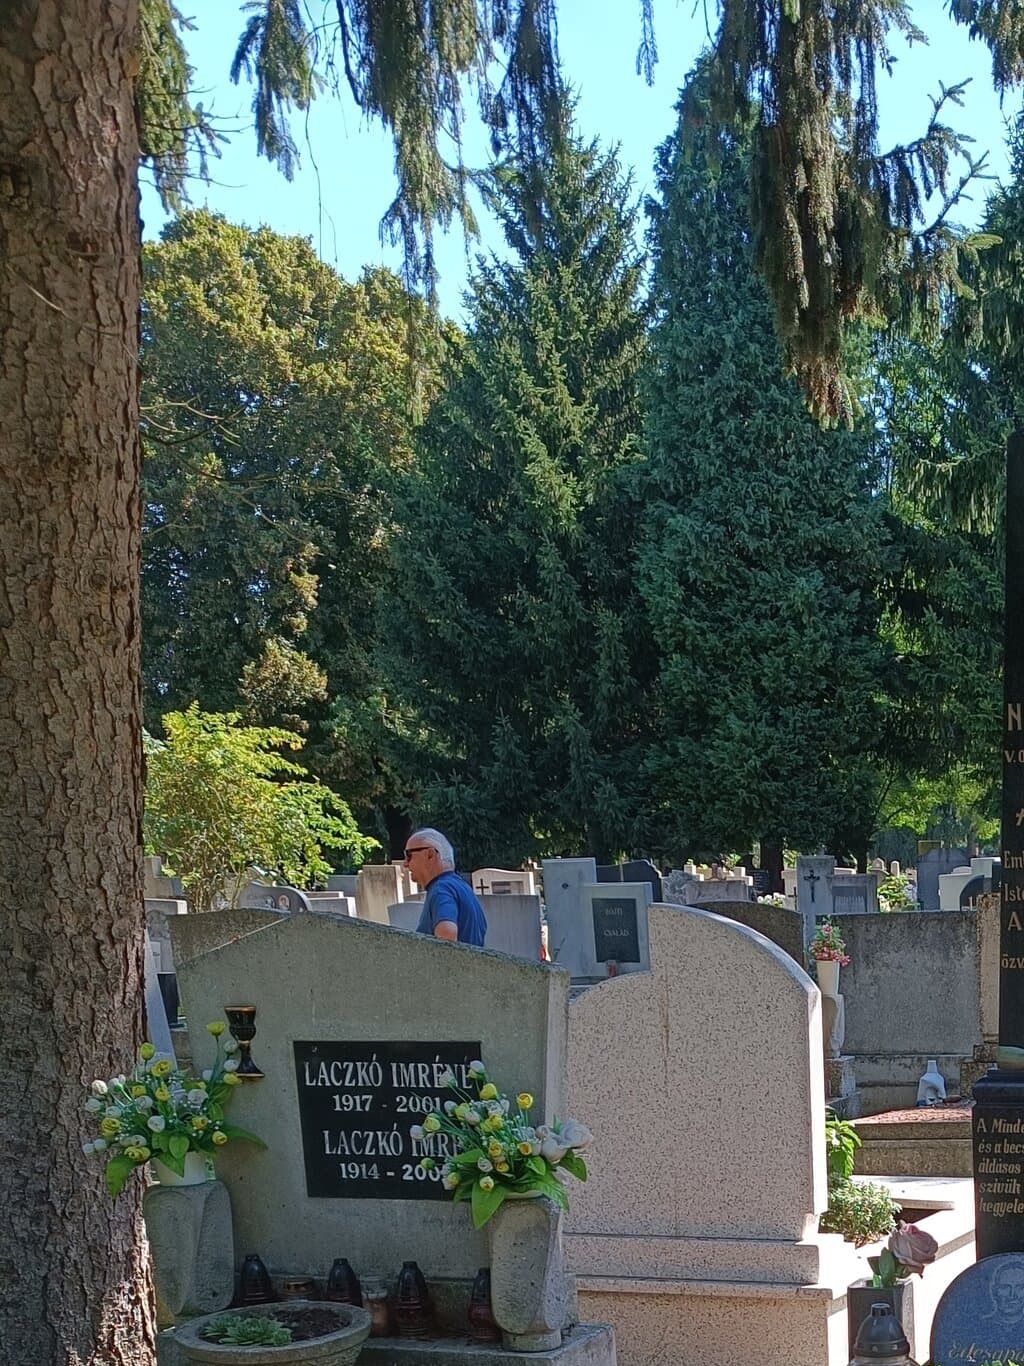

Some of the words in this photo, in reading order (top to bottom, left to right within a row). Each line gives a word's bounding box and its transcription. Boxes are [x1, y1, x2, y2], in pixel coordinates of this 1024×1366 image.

[1007, 912, 1022, 931] A
[305, 1053, 383, 1087] LACZKÓ
[332, 1094, 373, 1112] 1917
[976, 1118, 987, 1133] A
[323, 1123, 403, 1157] LACZKÓ
[978, 1139, 992, 1153] és
[339, 1162, 380, 1180] 1914
[402, 1164, 445, 1182] 200
